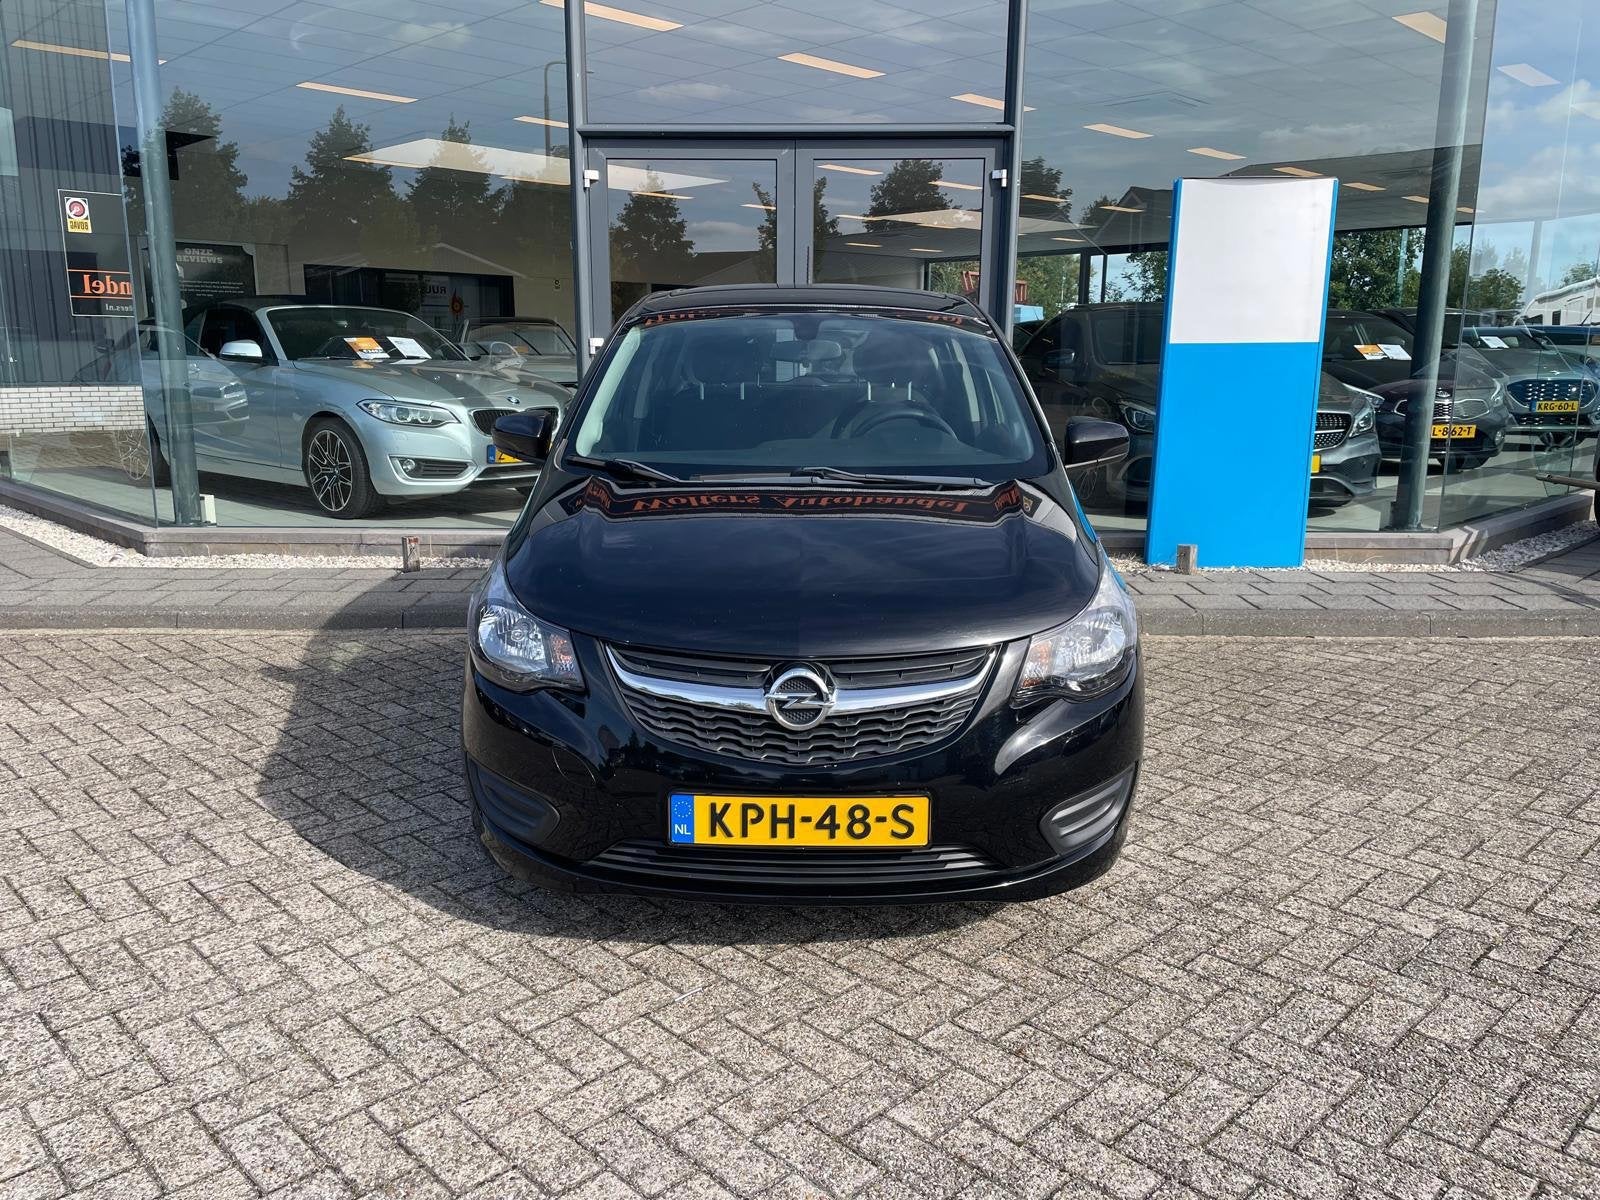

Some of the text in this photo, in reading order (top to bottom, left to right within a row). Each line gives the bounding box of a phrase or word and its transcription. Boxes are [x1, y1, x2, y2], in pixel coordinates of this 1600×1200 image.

[184, 248, 213, 256] ONZE
[176, 255, 223, 264] REVIEWS
[1537, 402, 1577, 411] KRG-60-L
[709, 802, 915, 840] KPH-48-S
[674, 824, 691, 835] NL
